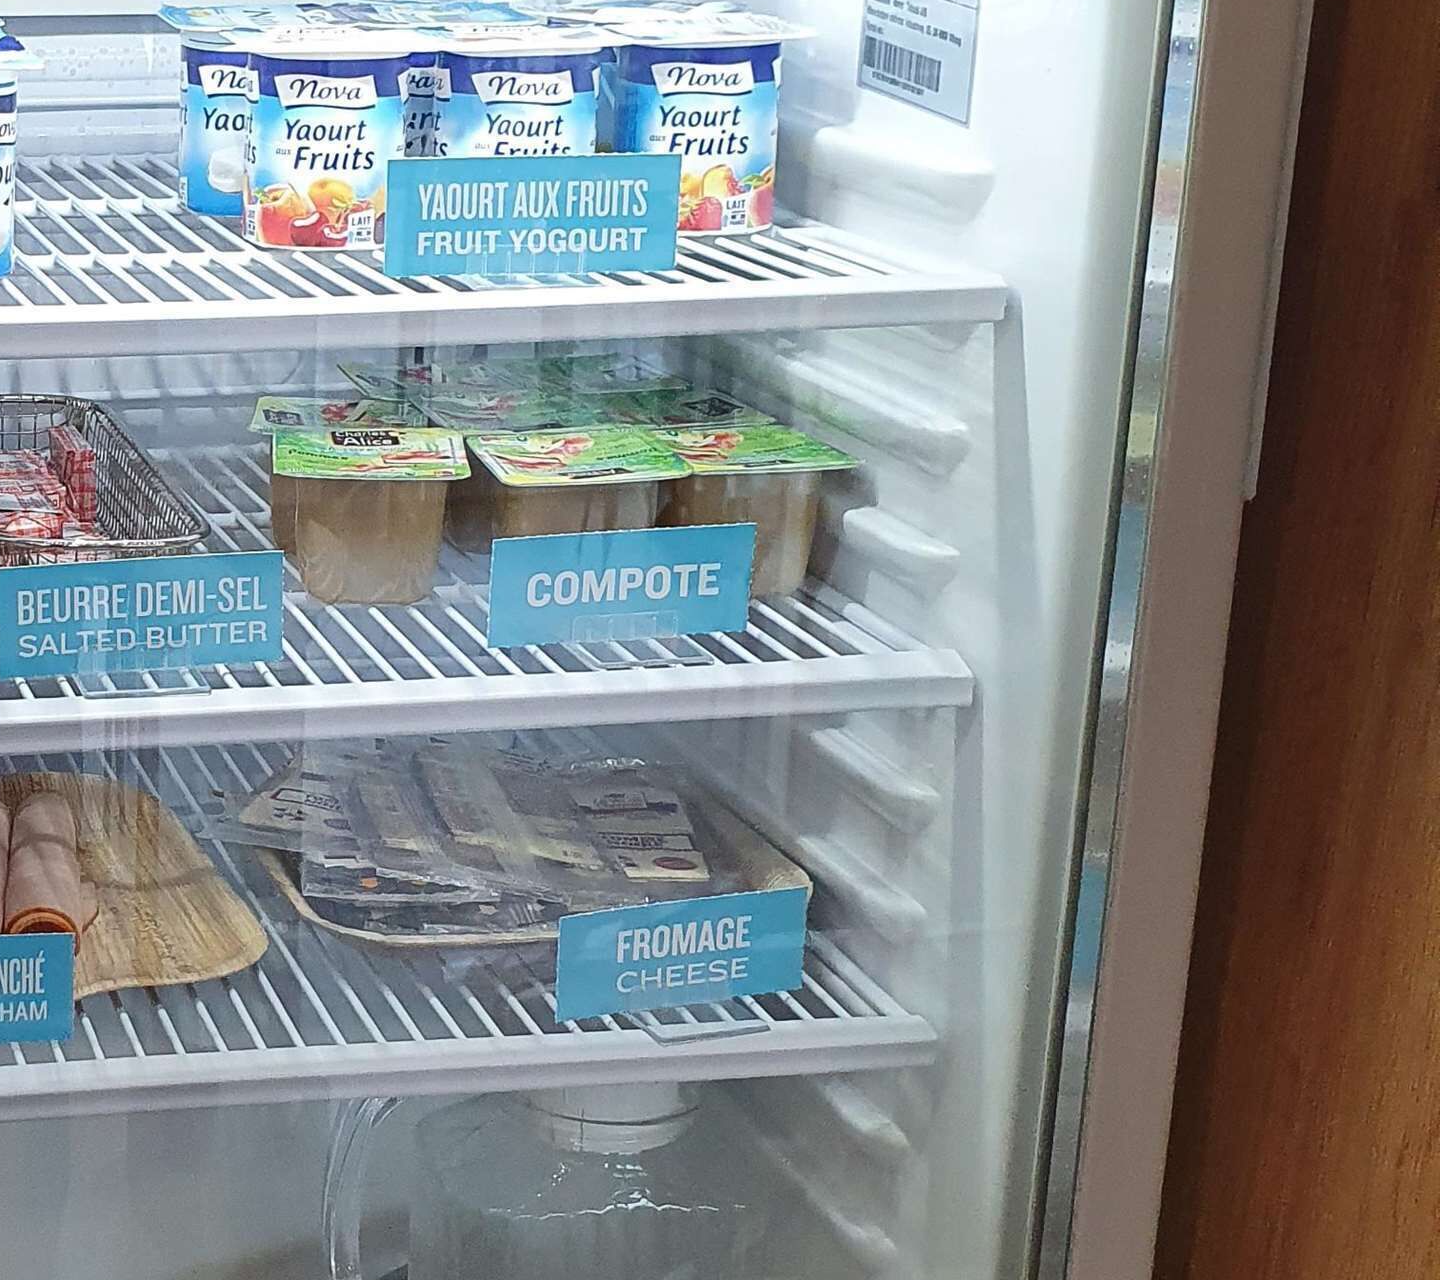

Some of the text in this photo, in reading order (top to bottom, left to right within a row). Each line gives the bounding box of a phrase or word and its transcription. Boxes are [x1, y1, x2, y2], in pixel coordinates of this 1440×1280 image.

[211, 69, 247, 90] No
[290, 77, 361, 101] Nova
[488, 75, 561, 97] Nova
[666, 66, 743, 87] Nova
[203, 106, 245, 132] Yao
[486, 112, 564, 137] Yaourt
[659, 104, 742, 127] Yaourt
[284, 118, 367, 141] Yaourt
[668, 129, 750, 156] Fruits
[293, 144, 375, 171] Fruits
[418, 178, 649, 221] YAOURT AUX FRUITS
[417, 226, 648, 256] FRUIT YOGOURT
[526, 562, 722, 608] COMPOTE
[17, 575, 268, 626] BEURRE DEMI-SEL
[18, 620, 268, 658] SALTED BUTTER
[615, 914, 753, 964] FROMAGE
[615, 956, 749, 994] CHEESE
[0, 999, 49, 1023] HAM
